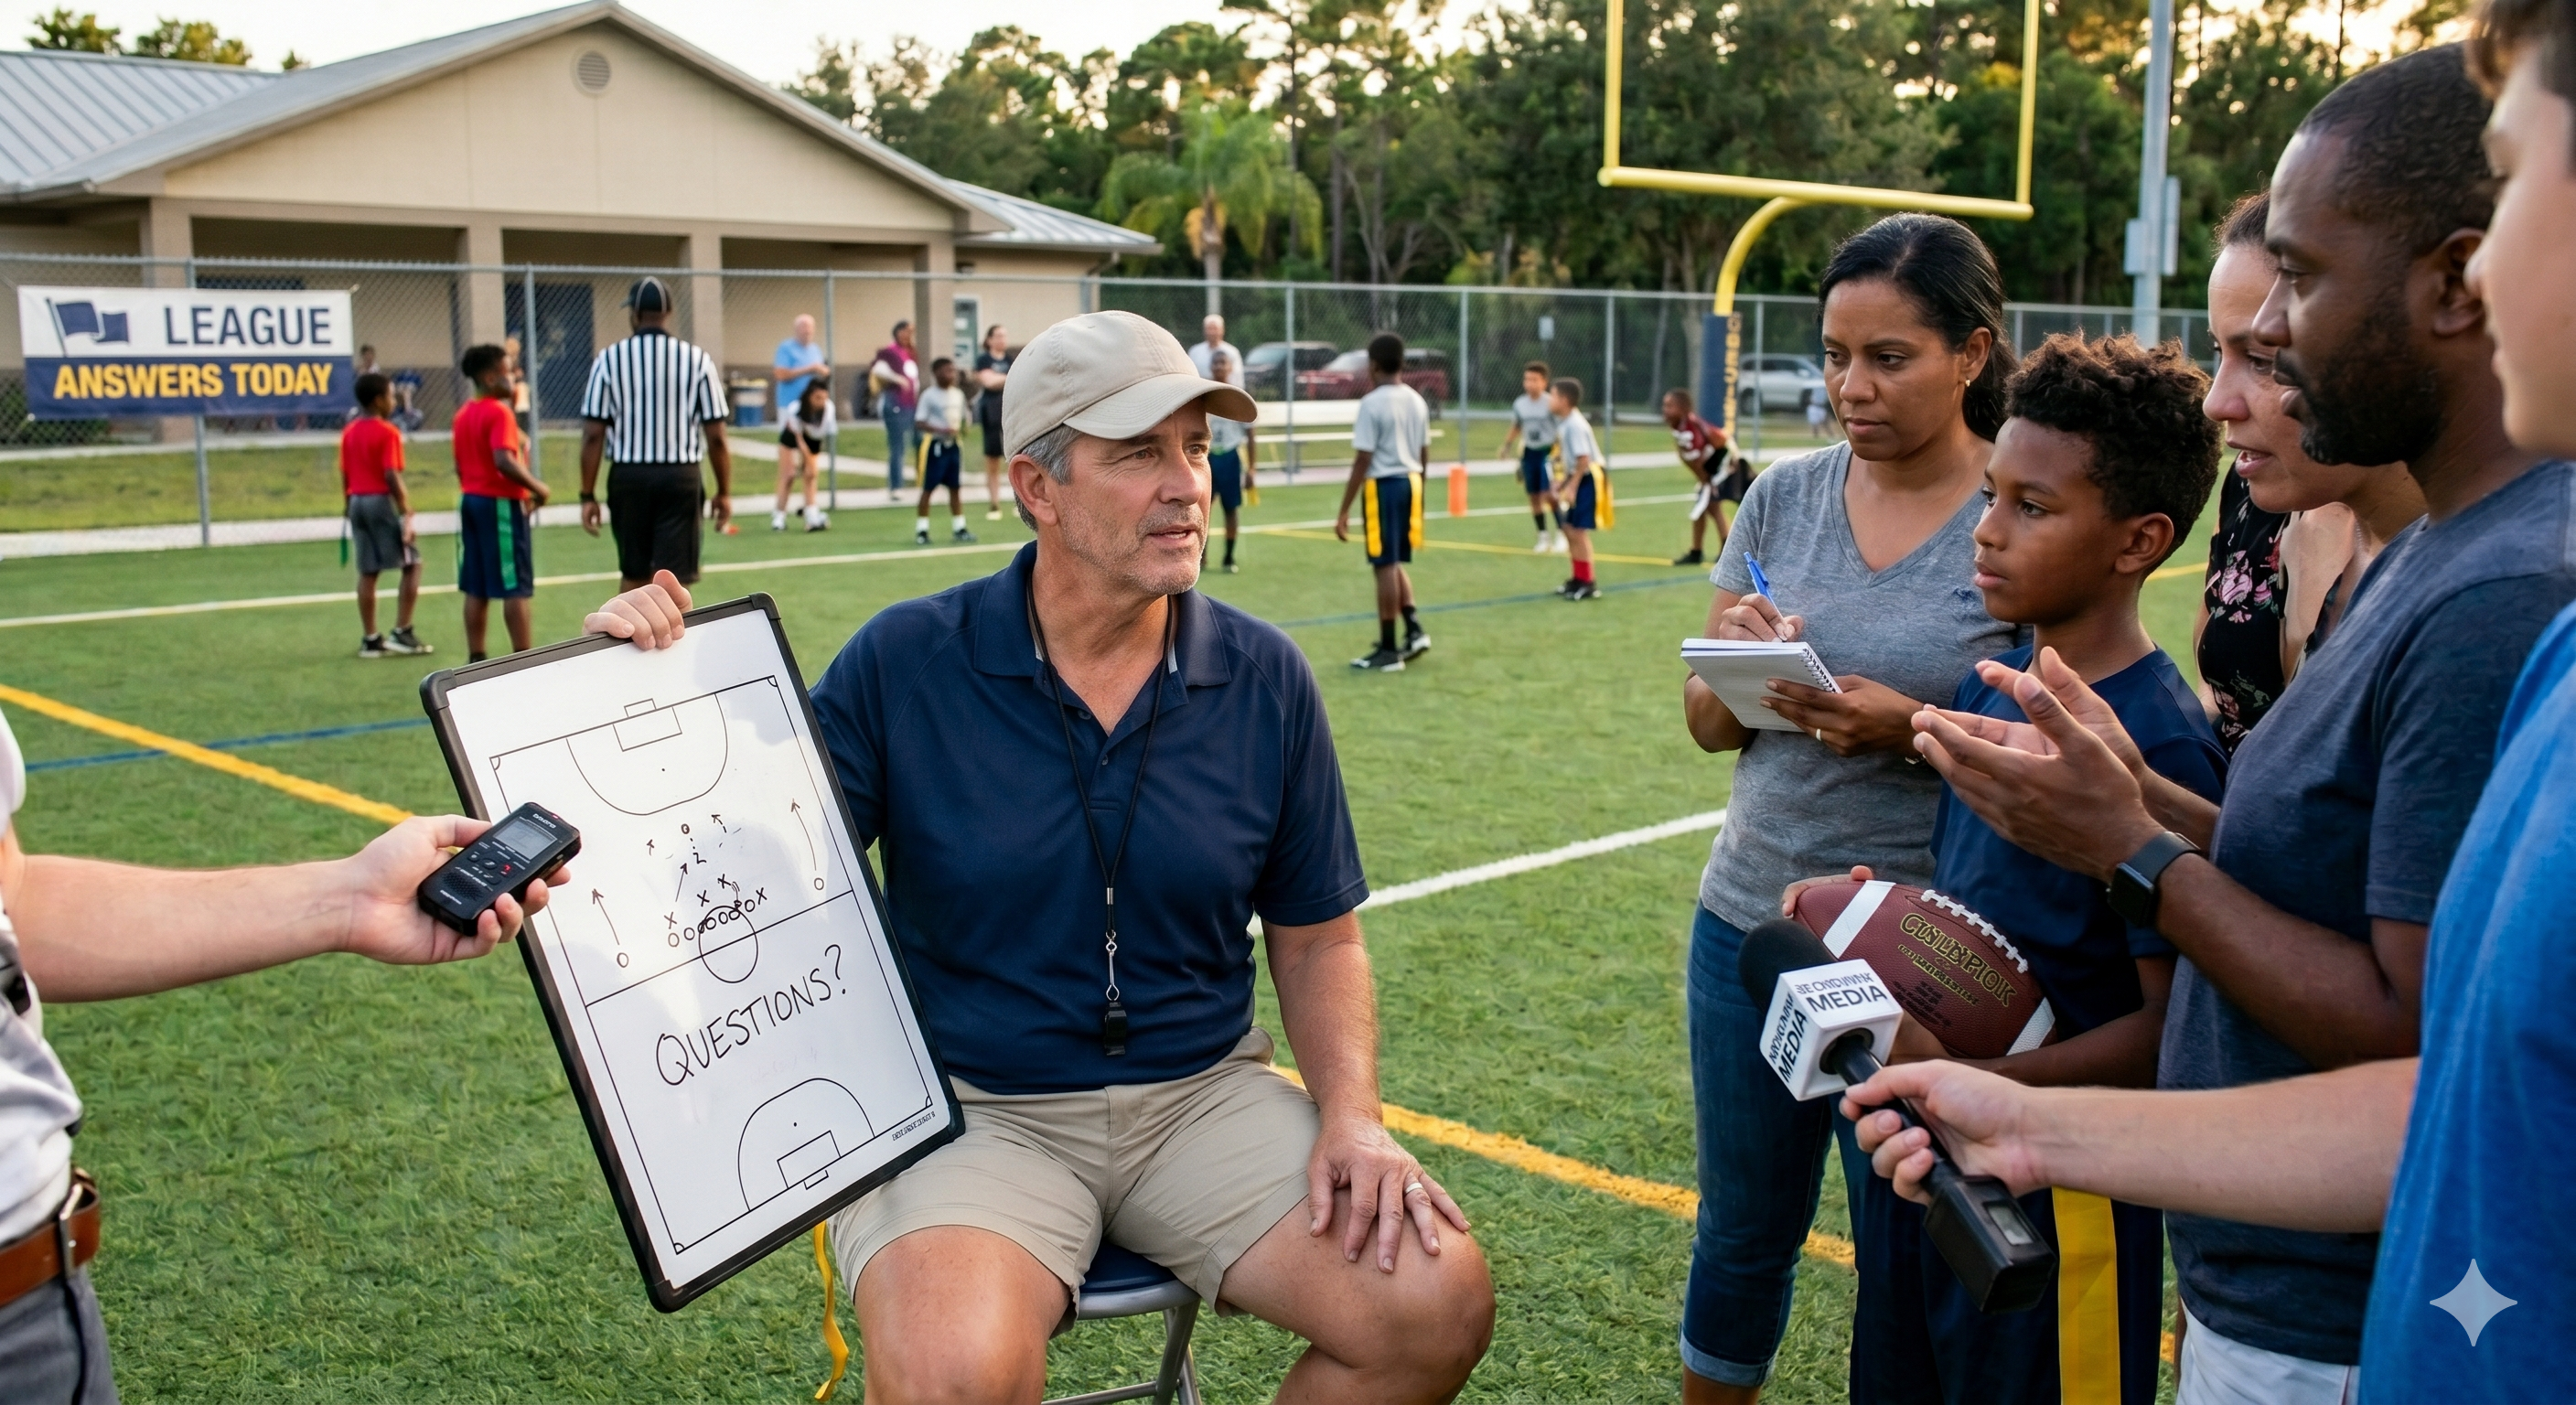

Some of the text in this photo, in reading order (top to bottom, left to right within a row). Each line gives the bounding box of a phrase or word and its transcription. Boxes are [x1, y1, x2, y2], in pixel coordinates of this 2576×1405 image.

[165, 306, 332, 346] LEAGUE
[53, 362, 333, 400] ANSWERS TODAY
[656, 944, 847, 1086] QUESTIONS?
[1806, 985, 1888, 1013] MEDIA
[1777, 1009, 1809, 1083] MEDIA
